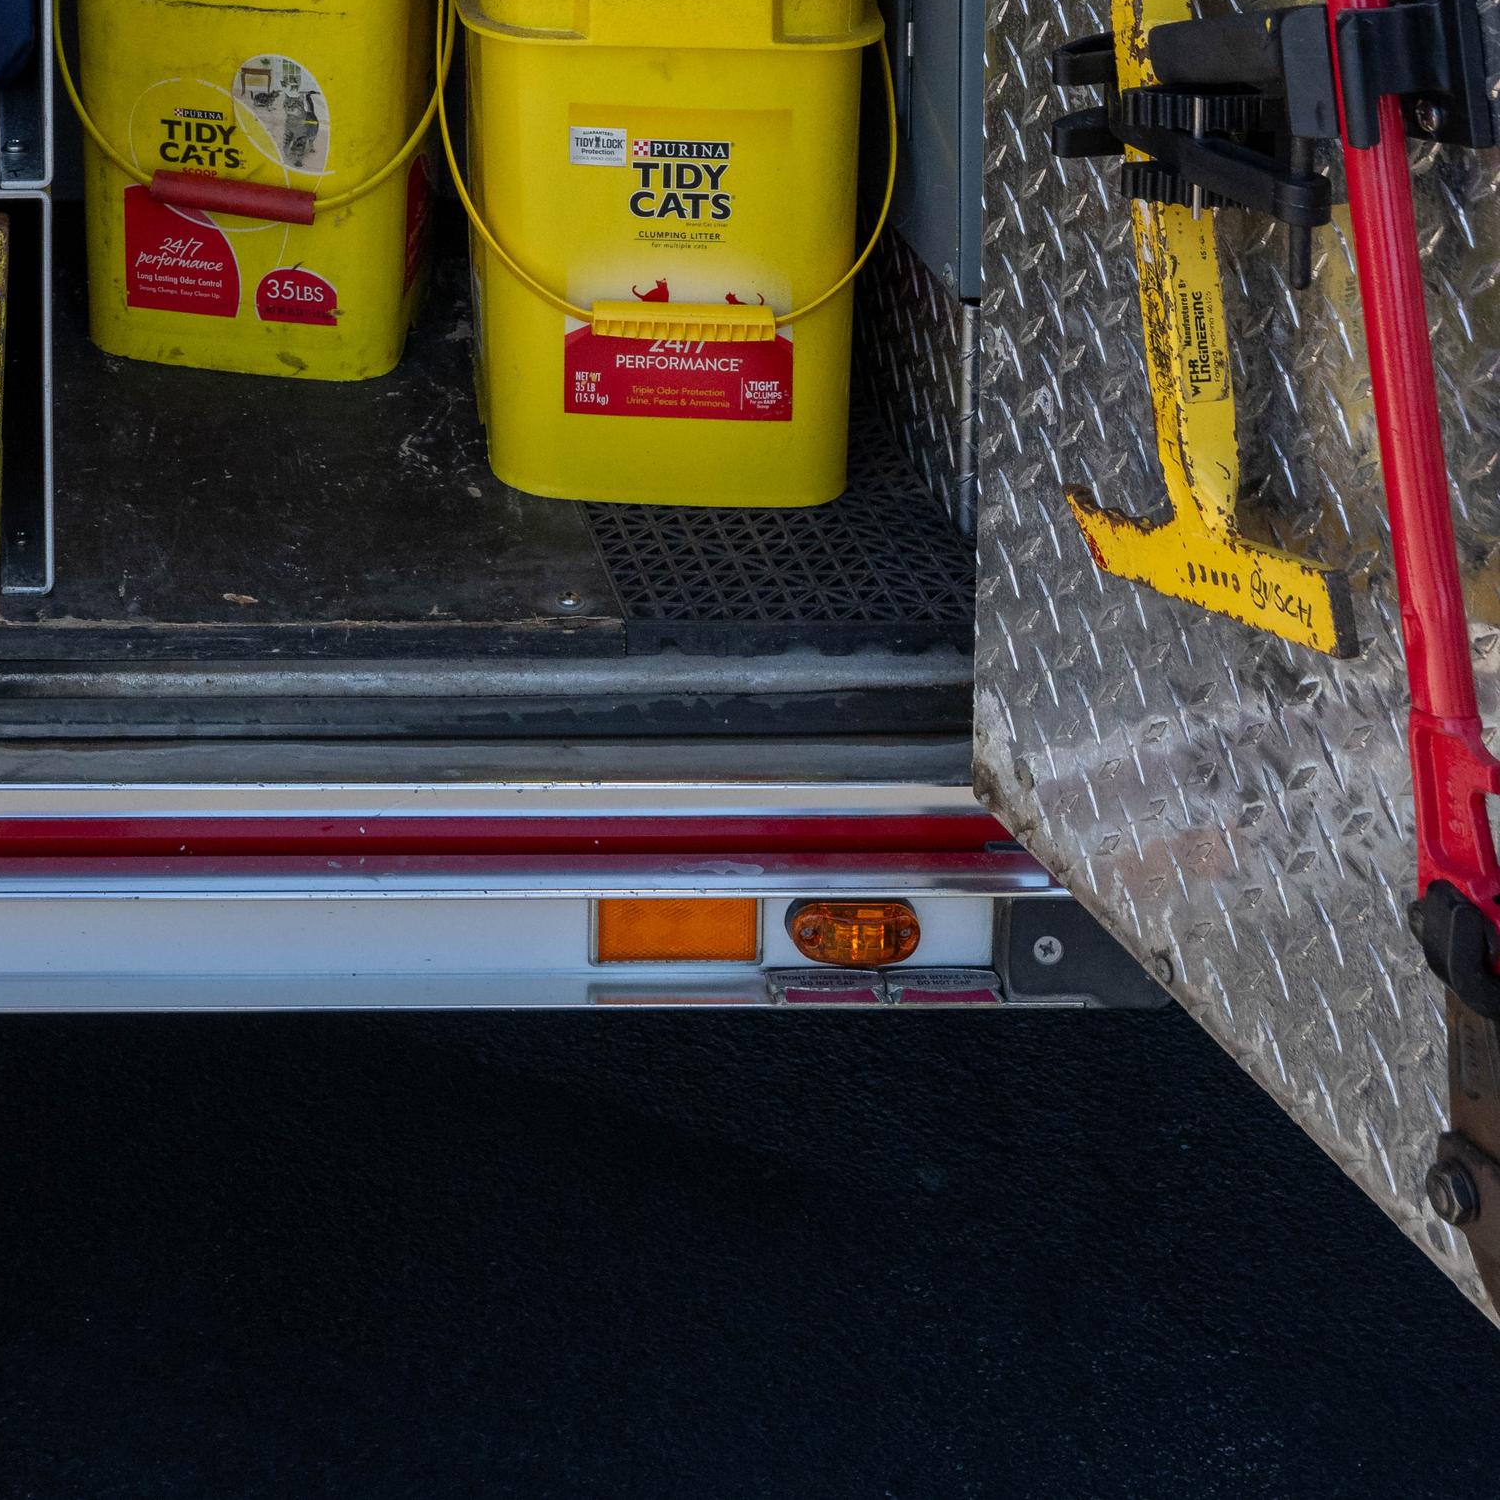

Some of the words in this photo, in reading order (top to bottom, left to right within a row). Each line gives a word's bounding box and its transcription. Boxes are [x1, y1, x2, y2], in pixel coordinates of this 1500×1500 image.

[184, 110, 222, 120] PURINA
[160, 118, 237, 146] TIDY
[574, 136, 594, 148] TIDY
[601, 138, 623, 149] LOCK
[159, 141, 240, 169] CATS
[581, 147, 615, 156] Protection
[653, 143, 727, 158] PURINA
[632, 162, 729, 190] TIDY
[629, 191, 732, 220] CATS
[638, 230, 687, 240] CLUMPING
[690, 232, 721, 240] LITTER
[159, 237, 204, 258] 24/7
[134, 250, 224, 272] performance
[136, 271, 153, 282] Long
[198, 278, 223, 288] Control
[1180, 292, 1192, 347] Manufactured
[615, 354, 740, 372] PERFORMANCE
[575, 372, 589, 381] NET
[575, 382, 585, 392] 35
[586, 382, 596, 392] LB
[632, 385, 654, 396] Triple
[656, 386, 681, 395] Odor
[682, 387, 726, 397] Protection
[749, 381, 780, 391] TIGHT
[574, 392, 595, 403] (15.9
[596, 393, 609, 406] kg)
[753, 391, 783, 400] CLUMPS
[653, 397, 678, 406] Feces
[679, 398, 687, 406] &
[688, 399, 731, 409] Ammonia
[1249, 568, 1314, 630] BUSCH
